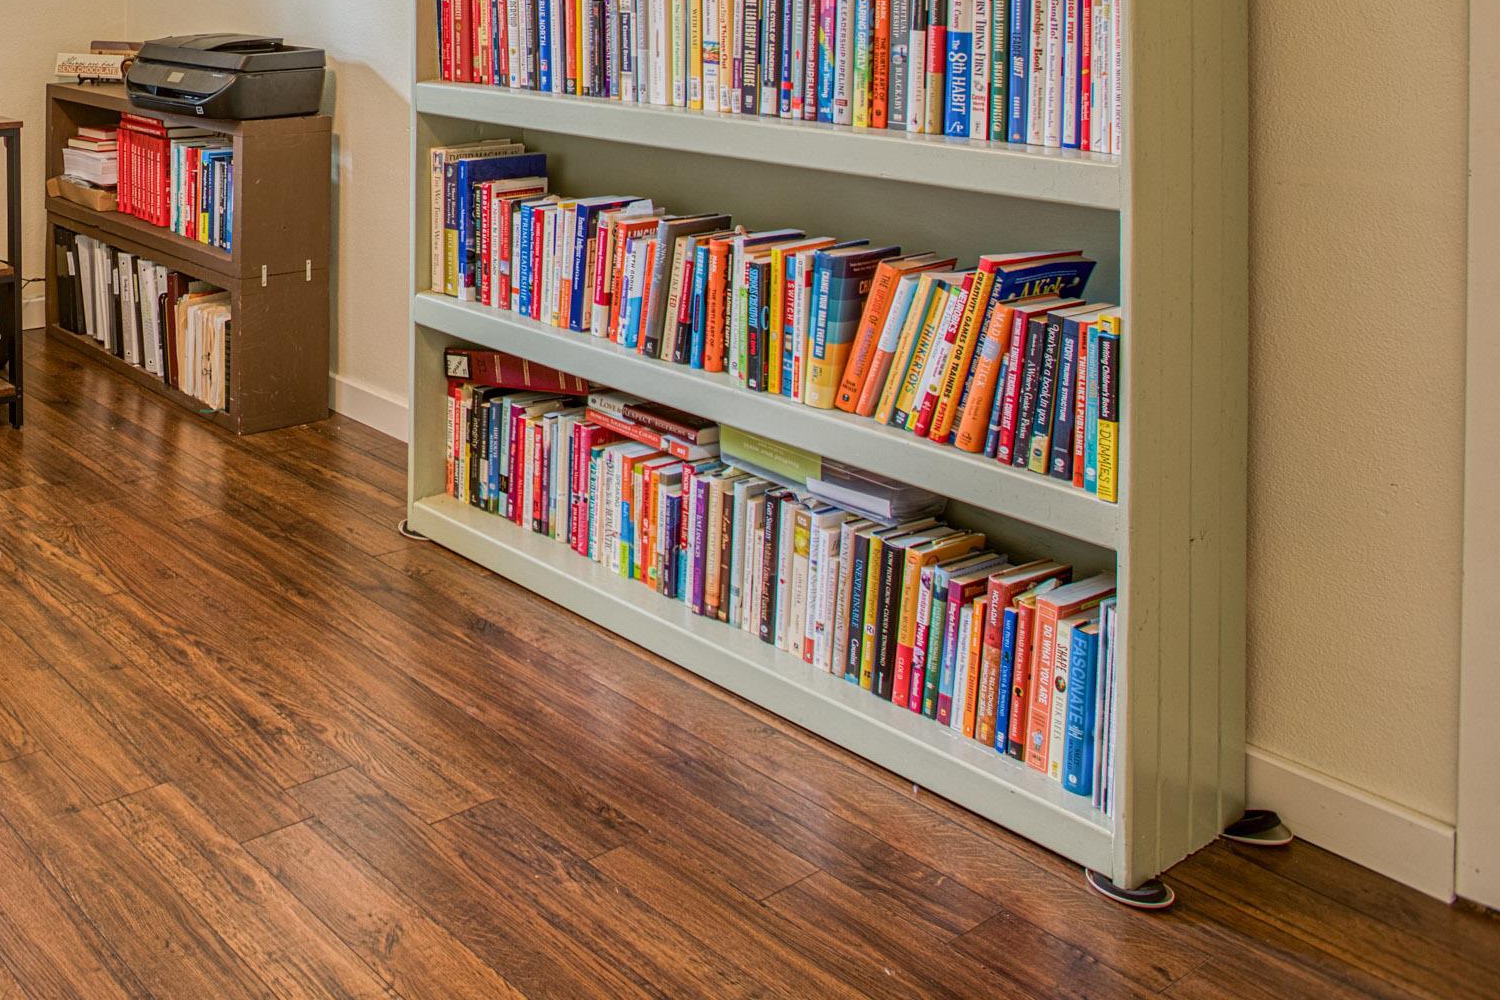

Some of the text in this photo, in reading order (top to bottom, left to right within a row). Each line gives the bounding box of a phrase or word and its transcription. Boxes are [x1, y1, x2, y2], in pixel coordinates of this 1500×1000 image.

[744, 8, 757, 48] LEADERSHIP
[769, 32, 776, 42] OF
[806, 16, 816, 61] LEADERSHIP
[839, 7, 848, 57] LEADERSHIP
[975, 20, 987, 50] THINGS
[995, 23, 1004, 52] SYNDROME
[1050, 23, 1058, 40] Ho!
[743, 50, 756, 87] CHALLENGE
[821, 17, 832, 98] Next Level Virtual Training
[857, 32, 867, 70] GREATLY
[974, 53, 986, 77] FIRST
[1033, 49, 1043, 73] Book
[59, 65, 117, 75] SEND CHOCOLATE
[805, 62, 815, 105] PIPELINE
[837, 60, 847, 96] PIPELINE
[948, 52, 967, 114] 8th HABIT
[879, 92, 885, 102] OF
[895, 67, 903, 111] BLACKABY
[521, 217, 529, 251] PRIMAL
[670, 294, 678, 308] TED
[749, 267, 759, 329] SERIOUS CREATIVITY
[787, 282, 795, 321] SWITCH
[868, 274, 891, 326] THE UPSIDE OF
[967, 272, 985, 314] CREATIVITY
[1020, 276, 1065, 297] A Kick
[815, 271, 829, 357] CHANGE YOUR BRAIN EVERY DAY
[948, 290, 968, 334] NEUROBICS
[959, 316, 972, 343] GAMES
[905, 323, 936, 395] THINKERTOYS
[954, 344, 964, 360] FOR
[976, 311, 1005, 388] MADE STICK
[944, 362, 960, 399] TRAINERS
[1024, 367, 1035, 391] Writer's
[1033, 324, 1059, 425] You've got you
[1059, 338, 1074, 422] STORY TRUMPS STRUCTURE
[934, 402, 947, 431] EPSTEIN
[1003, 403, 1014, 430] CONFLICT
[1023, 392, 1033, 411] Guide
[1099, 341, 1111, 483] Writing Children's Books DUMMIES
[471, 417, 480, 448] integrity
[1019, 418, 1029, 439] Fiction
[604, 508, 614, 552] ROMANTIC
[850, 559, 863, 665] UNEXPLAINABLE Cousins
[990, 590, 999, 626] HOLLADAY
[916, 624, 925, 646] People
[1038, 625, 1052, 705] DO WHAT YOU ARE
[1055, 643, 1068, 673] SHAPE
[987, 677, 995, 717] RELATIONSHIP
[1069, 636, 1088, 725] FASCINATE
